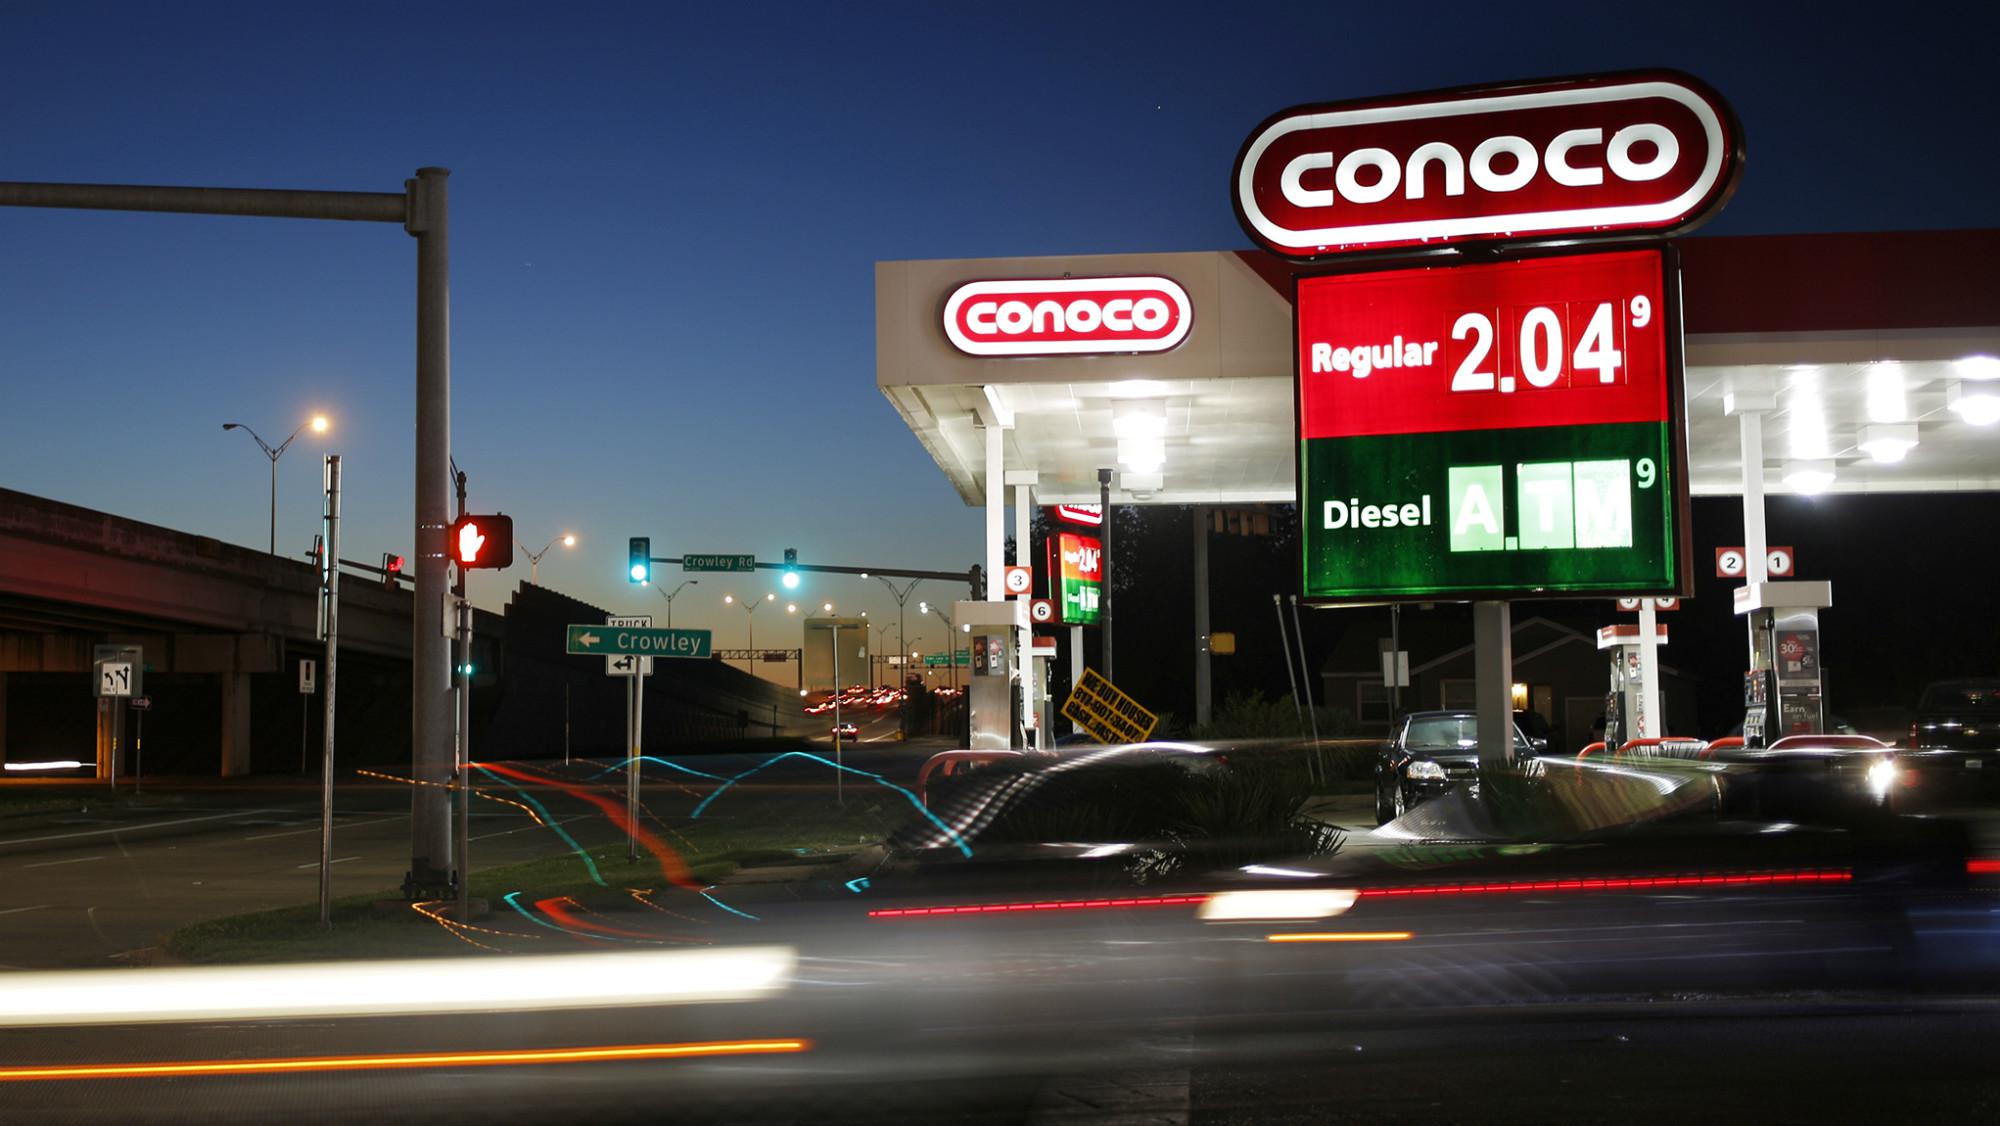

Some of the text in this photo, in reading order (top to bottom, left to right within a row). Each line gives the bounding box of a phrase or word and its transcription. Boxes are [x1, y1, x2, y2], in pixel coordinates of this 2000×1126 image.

[1311, 295, 1651, 393] Regular 2.04 9
[1323, 495, 1431, 529] Diesel
[1636, 458, 1656, 488] 9
[685, 556, 753, 569] Crowley Rd
[1726, 557, 1736, 569] 2
[1773, 557, 1781, 568] 1
[1013, 576, 1023, 586] 3
[1038, 606, 1046, 616] 6
[611, 619, 648, 627] TRUCK
[617, 632, 702, 655] Crowley
[1081, 672, 1154, 730] WE BUY HOUSES
[1066, 701, 1092, 725] CASH
